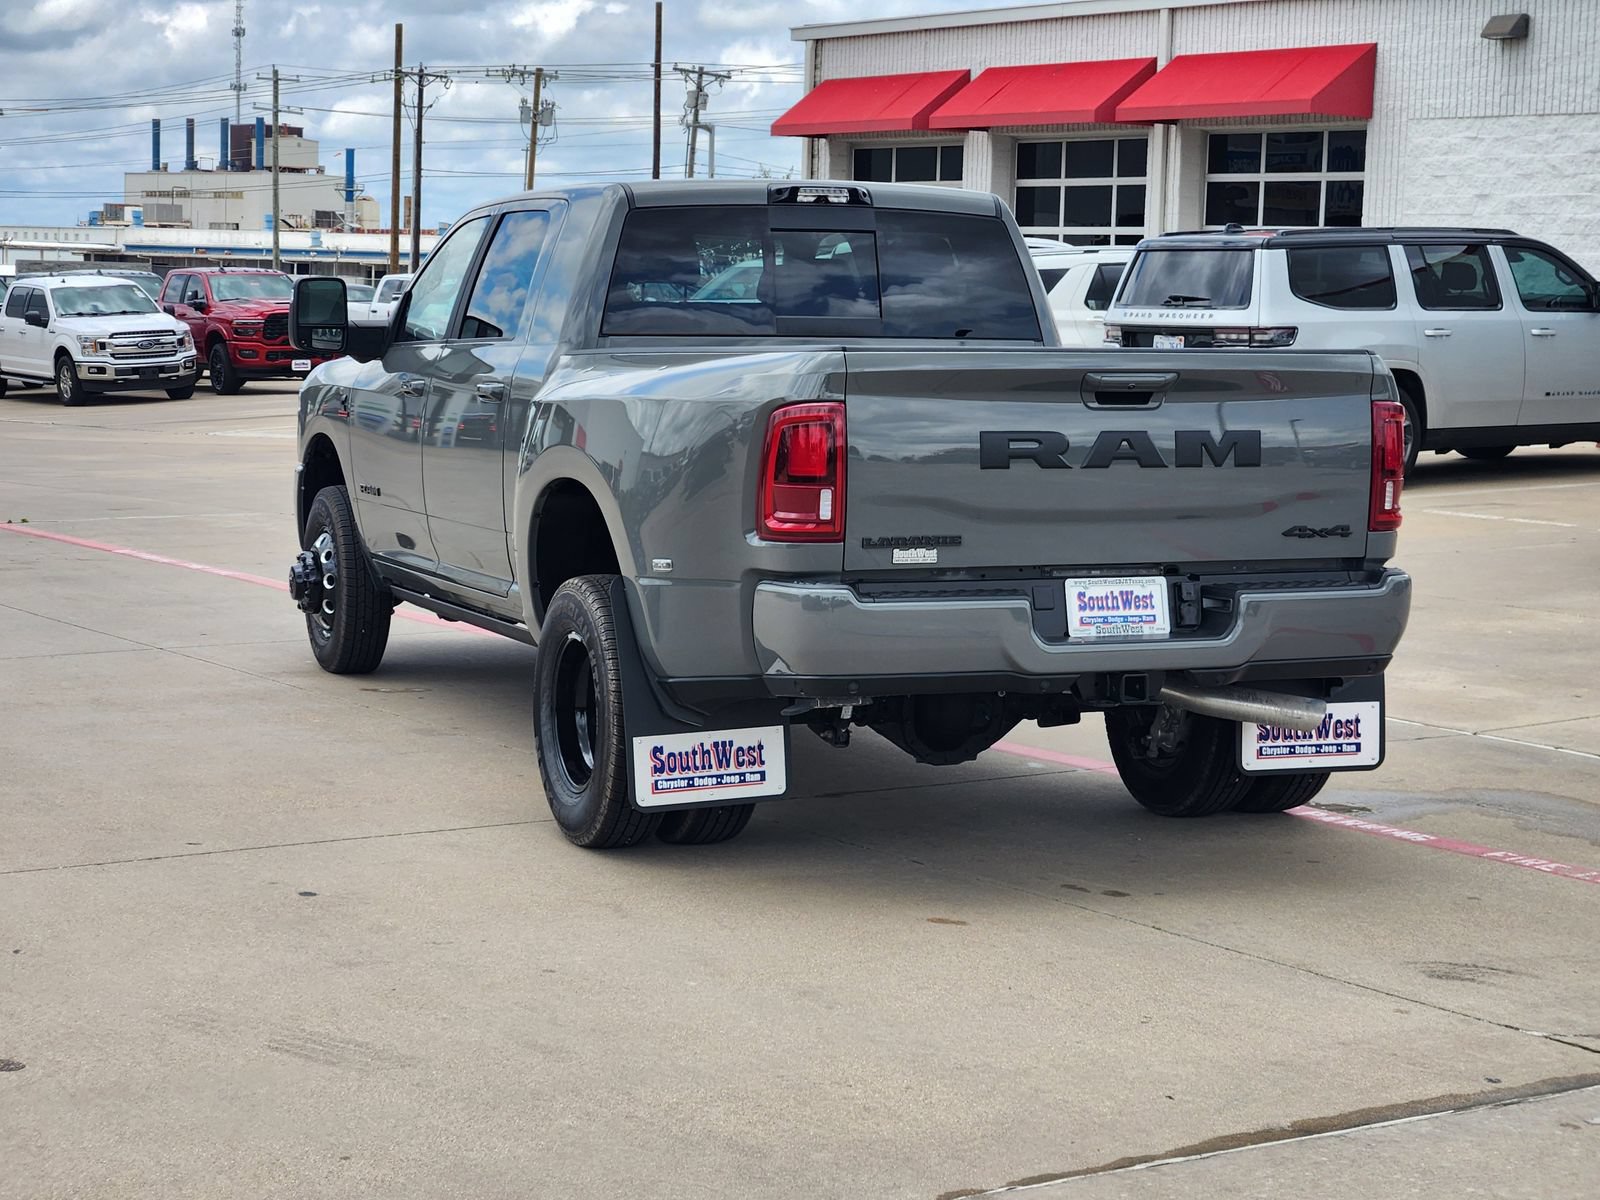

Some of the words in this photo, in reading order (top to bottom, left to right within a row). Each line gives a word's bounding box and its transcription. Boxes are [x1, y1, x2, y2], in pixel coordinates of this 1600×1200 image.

[1123, 311, 1153, 319] GRAND
[1158, 312, 1214, 320] WAGONEER
[979, 430, 1262, 469] RAM
[861, 534, 962, 549] LARAMIE
[1077, 589, 1156, 613] SouthWest
[1095, 624, 1145, 635] SouthWest
[1261, 745, 1290, 757] Chrysler
[1295, 744, 1316, 754] Dodge
[1320, 743, 1338, 753] Jeep
[1342, 742, 1357, 752] Ram
[650, 738, 766, 778] SouthWest
[657, 778, 689, 790] Chrysler
[693, 775, 717, 787] Dodge
[721, 774, 740, 784] Jeep
[745, 772, 761, 782] Ram
